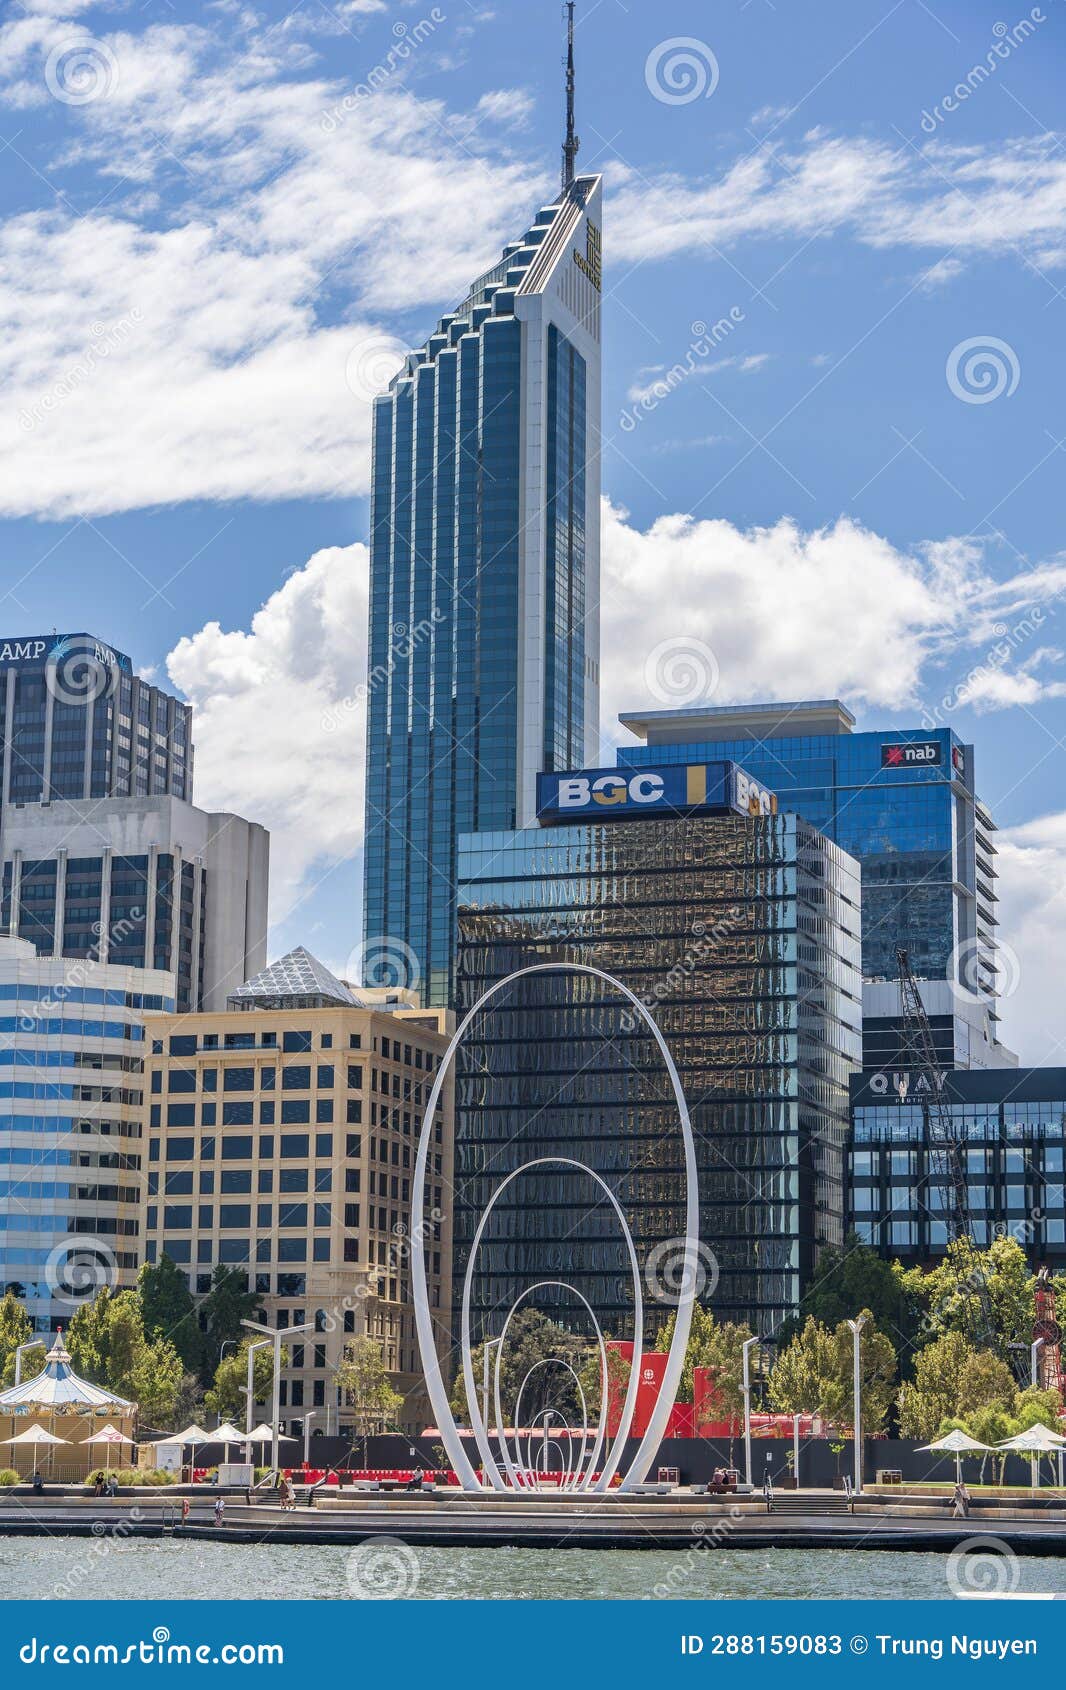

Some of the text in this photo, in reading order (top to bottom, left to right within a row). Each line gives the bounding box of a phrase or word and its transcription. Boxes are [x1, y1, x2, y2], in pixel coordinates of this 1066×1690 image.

[0, 641, 46, 660] AMP
[94, 643, 116, 667] AMP
[905, 745, 936, 761] nab
[558, 774, 665, 808] BGC
[869, 1071, 949, 1095] QUAY
